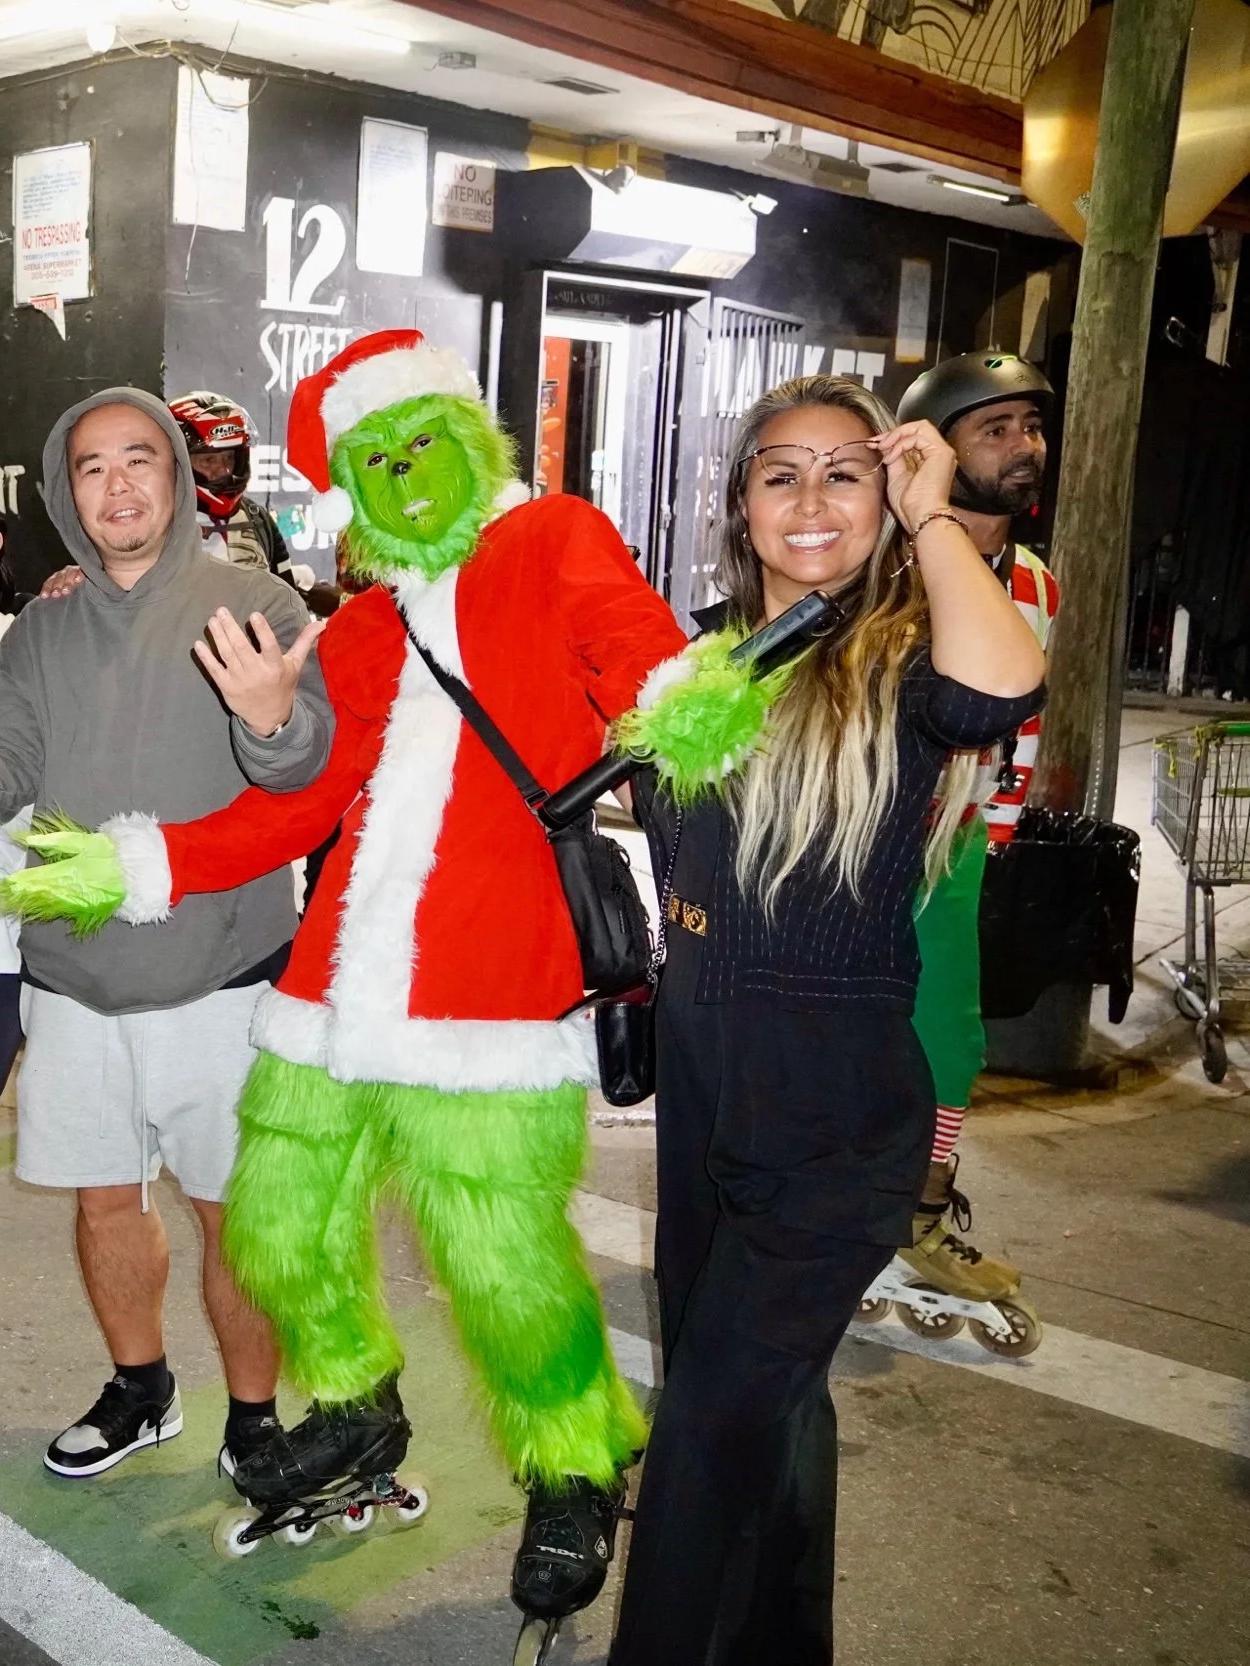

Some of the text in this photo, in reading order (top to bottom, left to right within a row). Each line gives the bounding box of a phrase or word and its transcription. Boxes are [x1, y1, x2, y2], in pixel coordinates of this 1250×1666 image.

[454, 163, 477, 182] NO
[22, 221, 82, 250] NO TRESPASSING
[260, 196, 347, 315] 12
